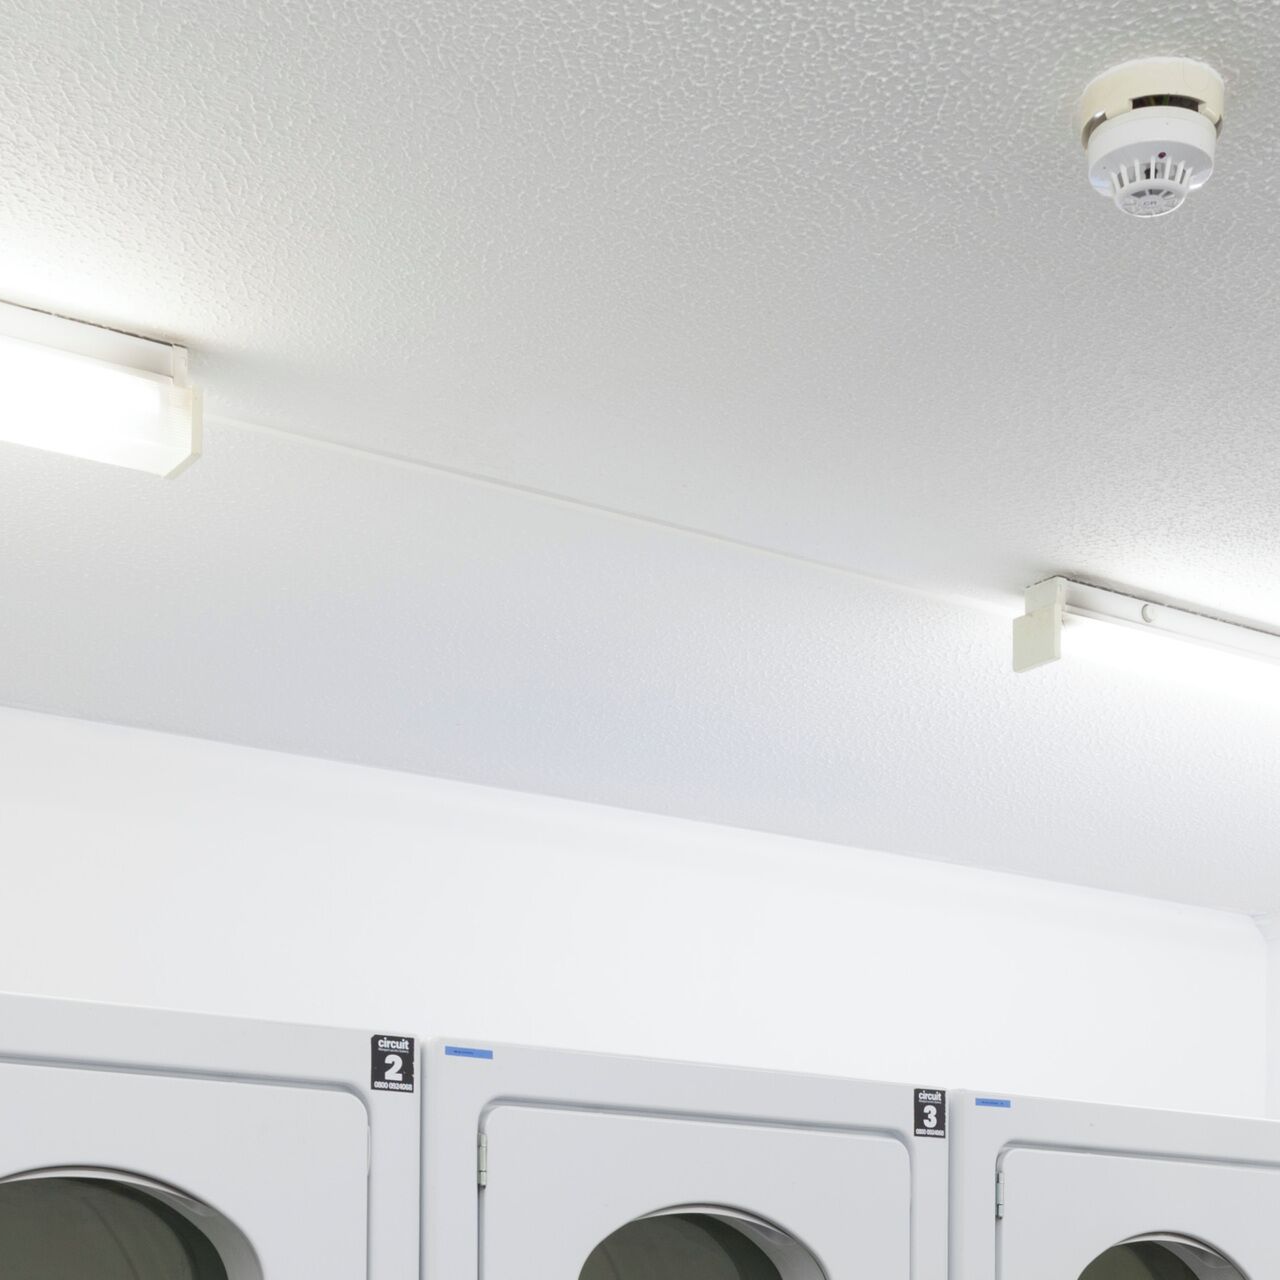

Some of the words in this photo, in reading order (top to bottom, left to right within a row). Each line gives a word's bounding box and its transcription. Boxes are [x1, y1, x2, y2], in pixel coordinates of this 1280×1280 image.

[378, 1037, 409, 1049] circuit
[385, 1054, 402, 1080] 2
[919, 1090, 941, 1101] circuit
[923, 1105, 937, 1128] 3
